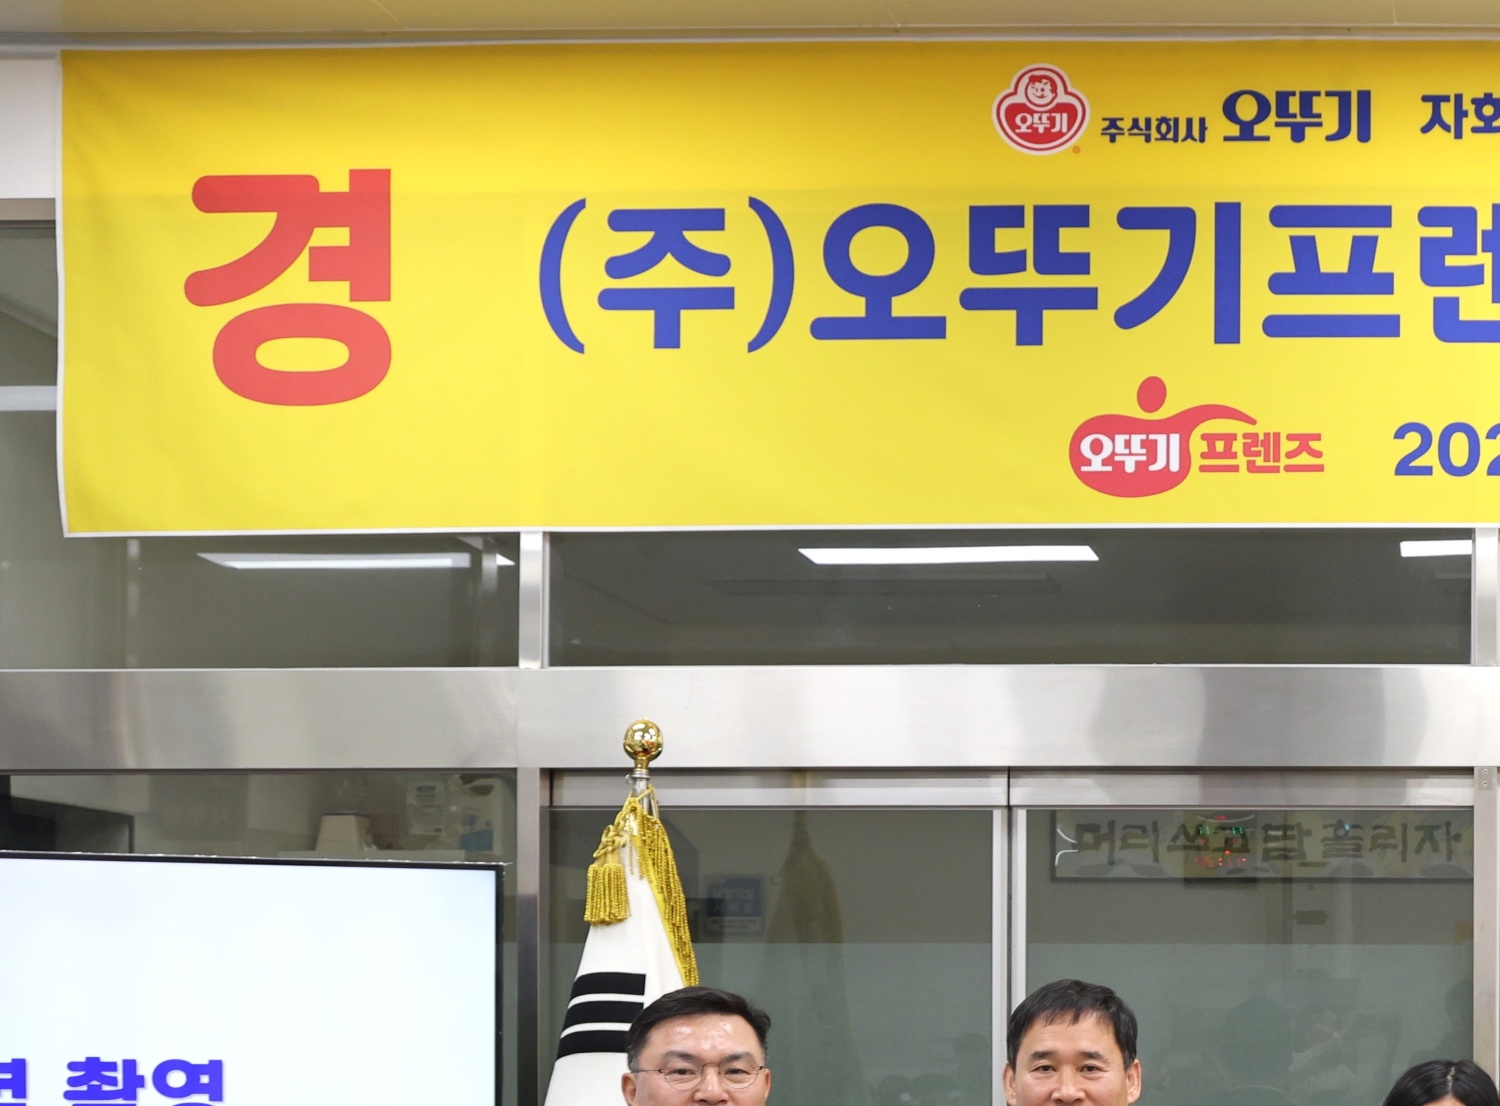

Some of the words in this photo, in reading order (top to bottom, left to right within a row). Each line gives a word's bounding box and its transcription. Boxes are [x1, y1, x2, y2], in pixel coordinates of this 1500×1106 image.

[1014, 111, 1069, 134] 오뚜기
[1099, 116, 1208, 144] 주식회사
[1222, 89, 1372, 144] 오뚜기
[183, 167, 393, 408] 경
[1079, 432, 1181, 474] 오뚜기
[1198, 431, 1325, 474] 프렌즈
